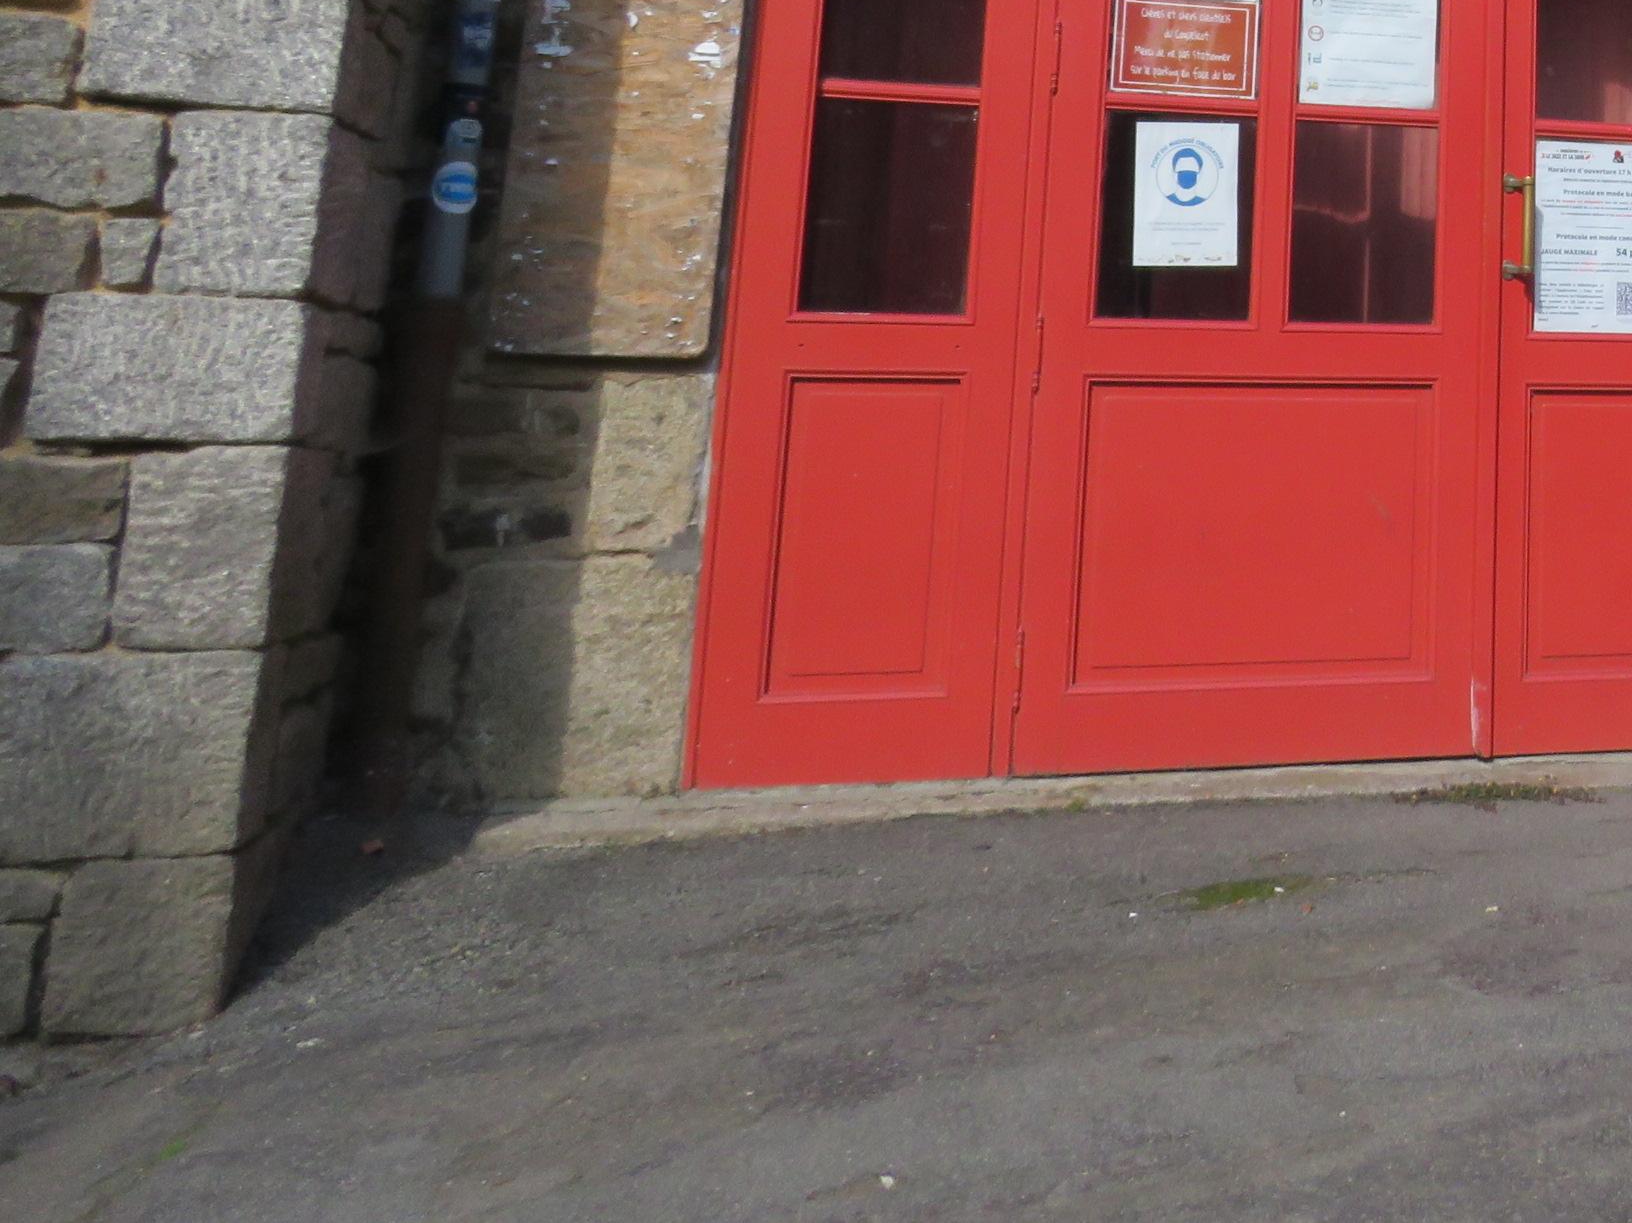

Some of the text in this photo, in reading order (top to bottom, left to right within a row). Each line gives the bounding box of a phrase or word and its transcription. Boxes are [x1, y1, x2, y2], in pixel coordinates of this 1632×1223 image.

[1563, 189, 1596, 197] Protocole
[1556, 233, 1588, 241] Protocole
[1563, 248, 1597, 256] MAXIMALE
[1616, 248, 1628, 257] 54
